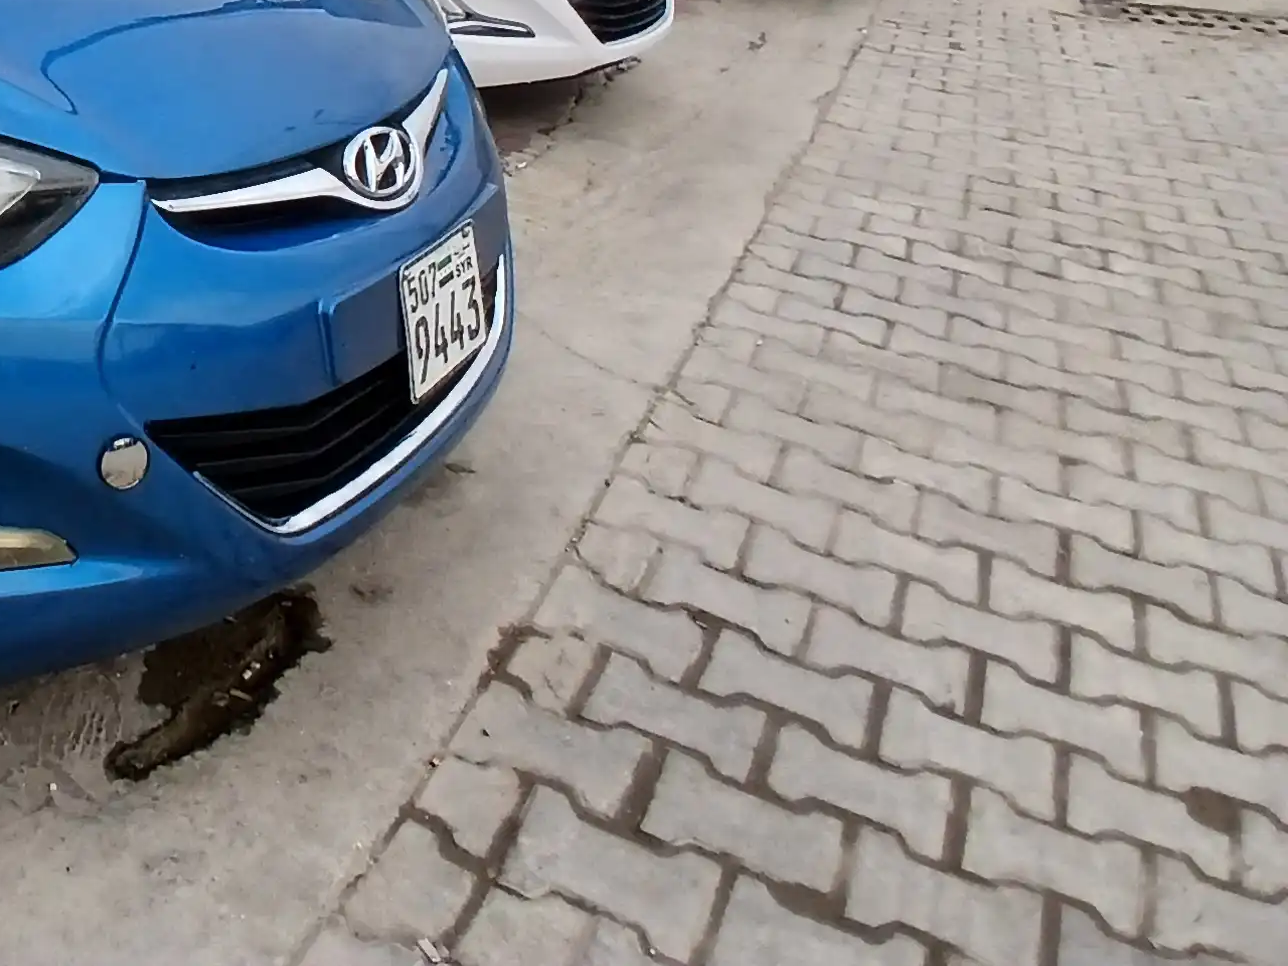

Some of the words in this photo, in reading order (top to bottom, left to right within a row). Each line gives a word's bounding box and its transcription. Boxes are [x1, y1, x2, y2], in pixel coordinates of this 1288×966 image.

[406, 261, 437, 314] 507
[454, 255, 473, 278] SYR
[415, 275, 481, 385] 9443
